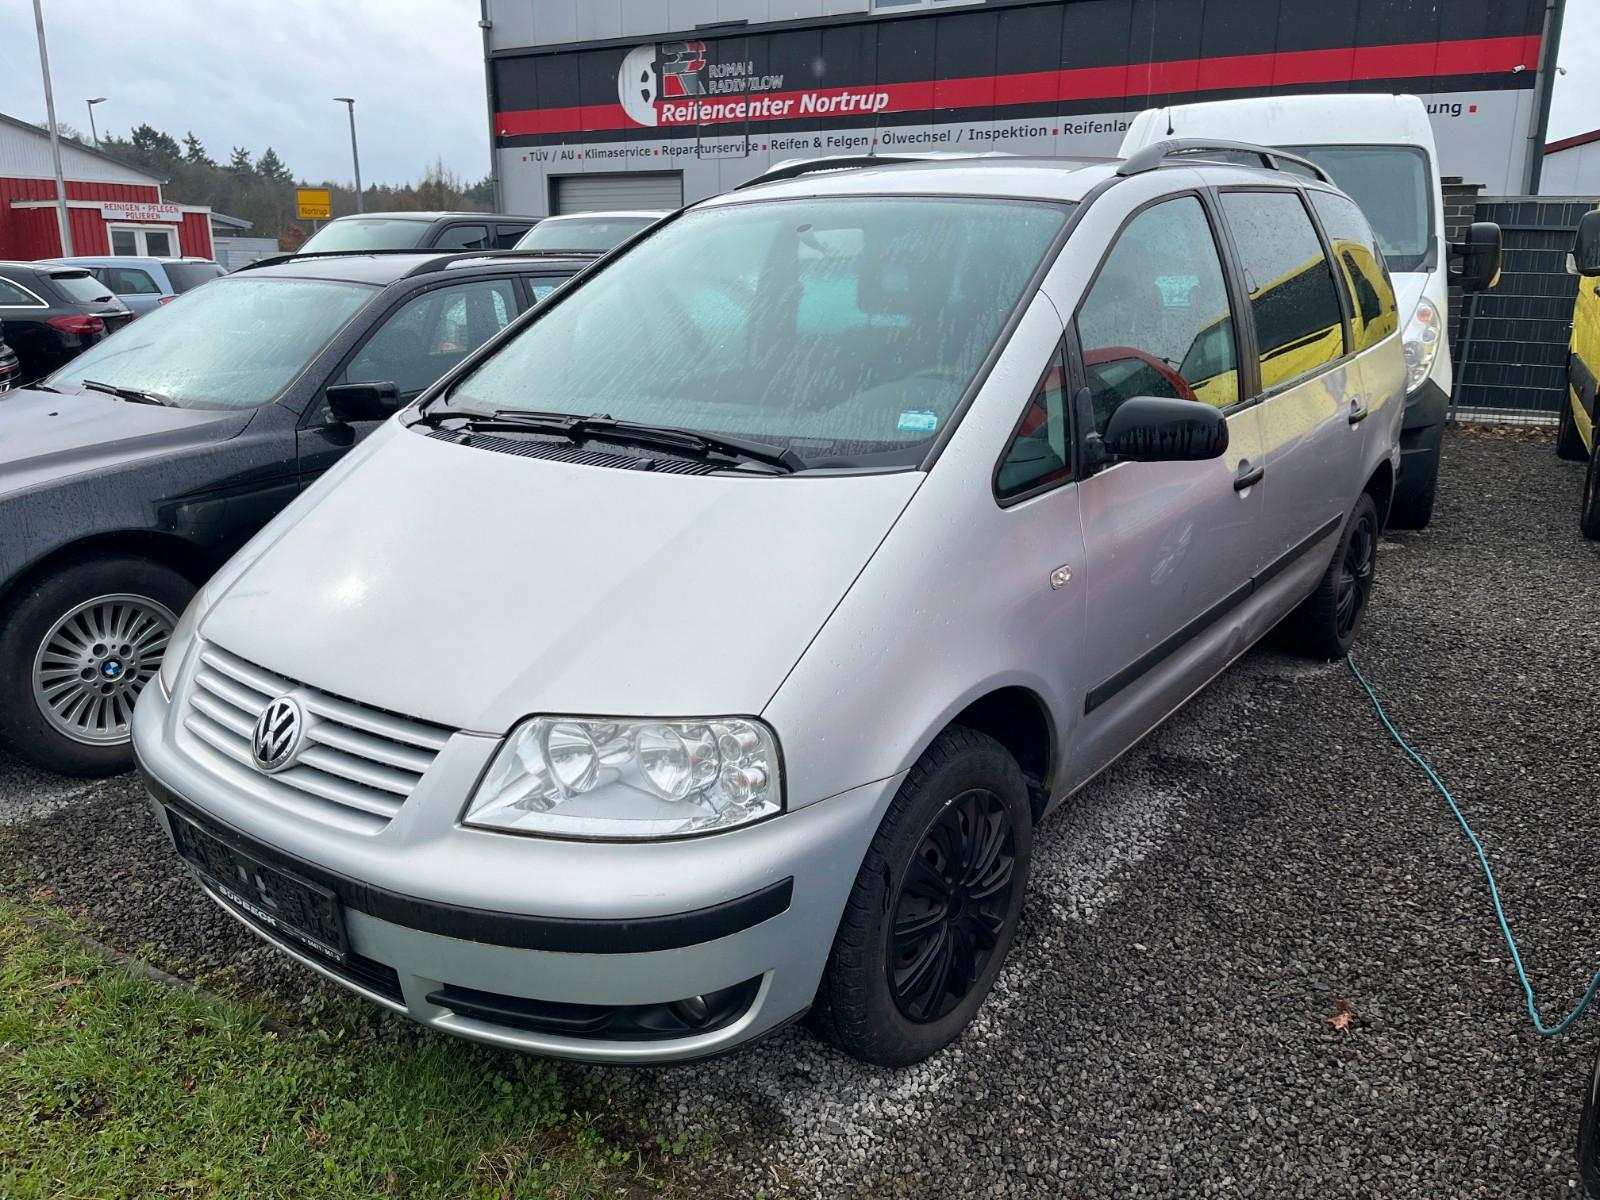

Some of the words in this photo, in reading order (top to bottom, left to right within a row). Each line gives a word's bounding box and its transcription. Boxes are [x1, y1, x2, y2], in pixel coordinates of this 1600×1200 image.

[661, 99, 794, 122] Reifencenter
[800, 91, 889, 114] Nortrup
[529, 148, 550, 162] TÜV
[560, 149, 575, 161] AU
[585, 147, 651, 160] Klimaservice
[662, 141, 758, 156] Reparaturservice
[771, 137, 809, 151] Reifen
[813, 136, 823, 148] &
[826, 135, 869, 150] Felgen
[882, 130, 951, 145] Ölwechsel
[956, 129, 963, 143] /
[968, 125, 1047, 142] Inspektion
[104, 203, 139, 212] REINIGEN
[125, 211, 160, 220] POLIEREN
